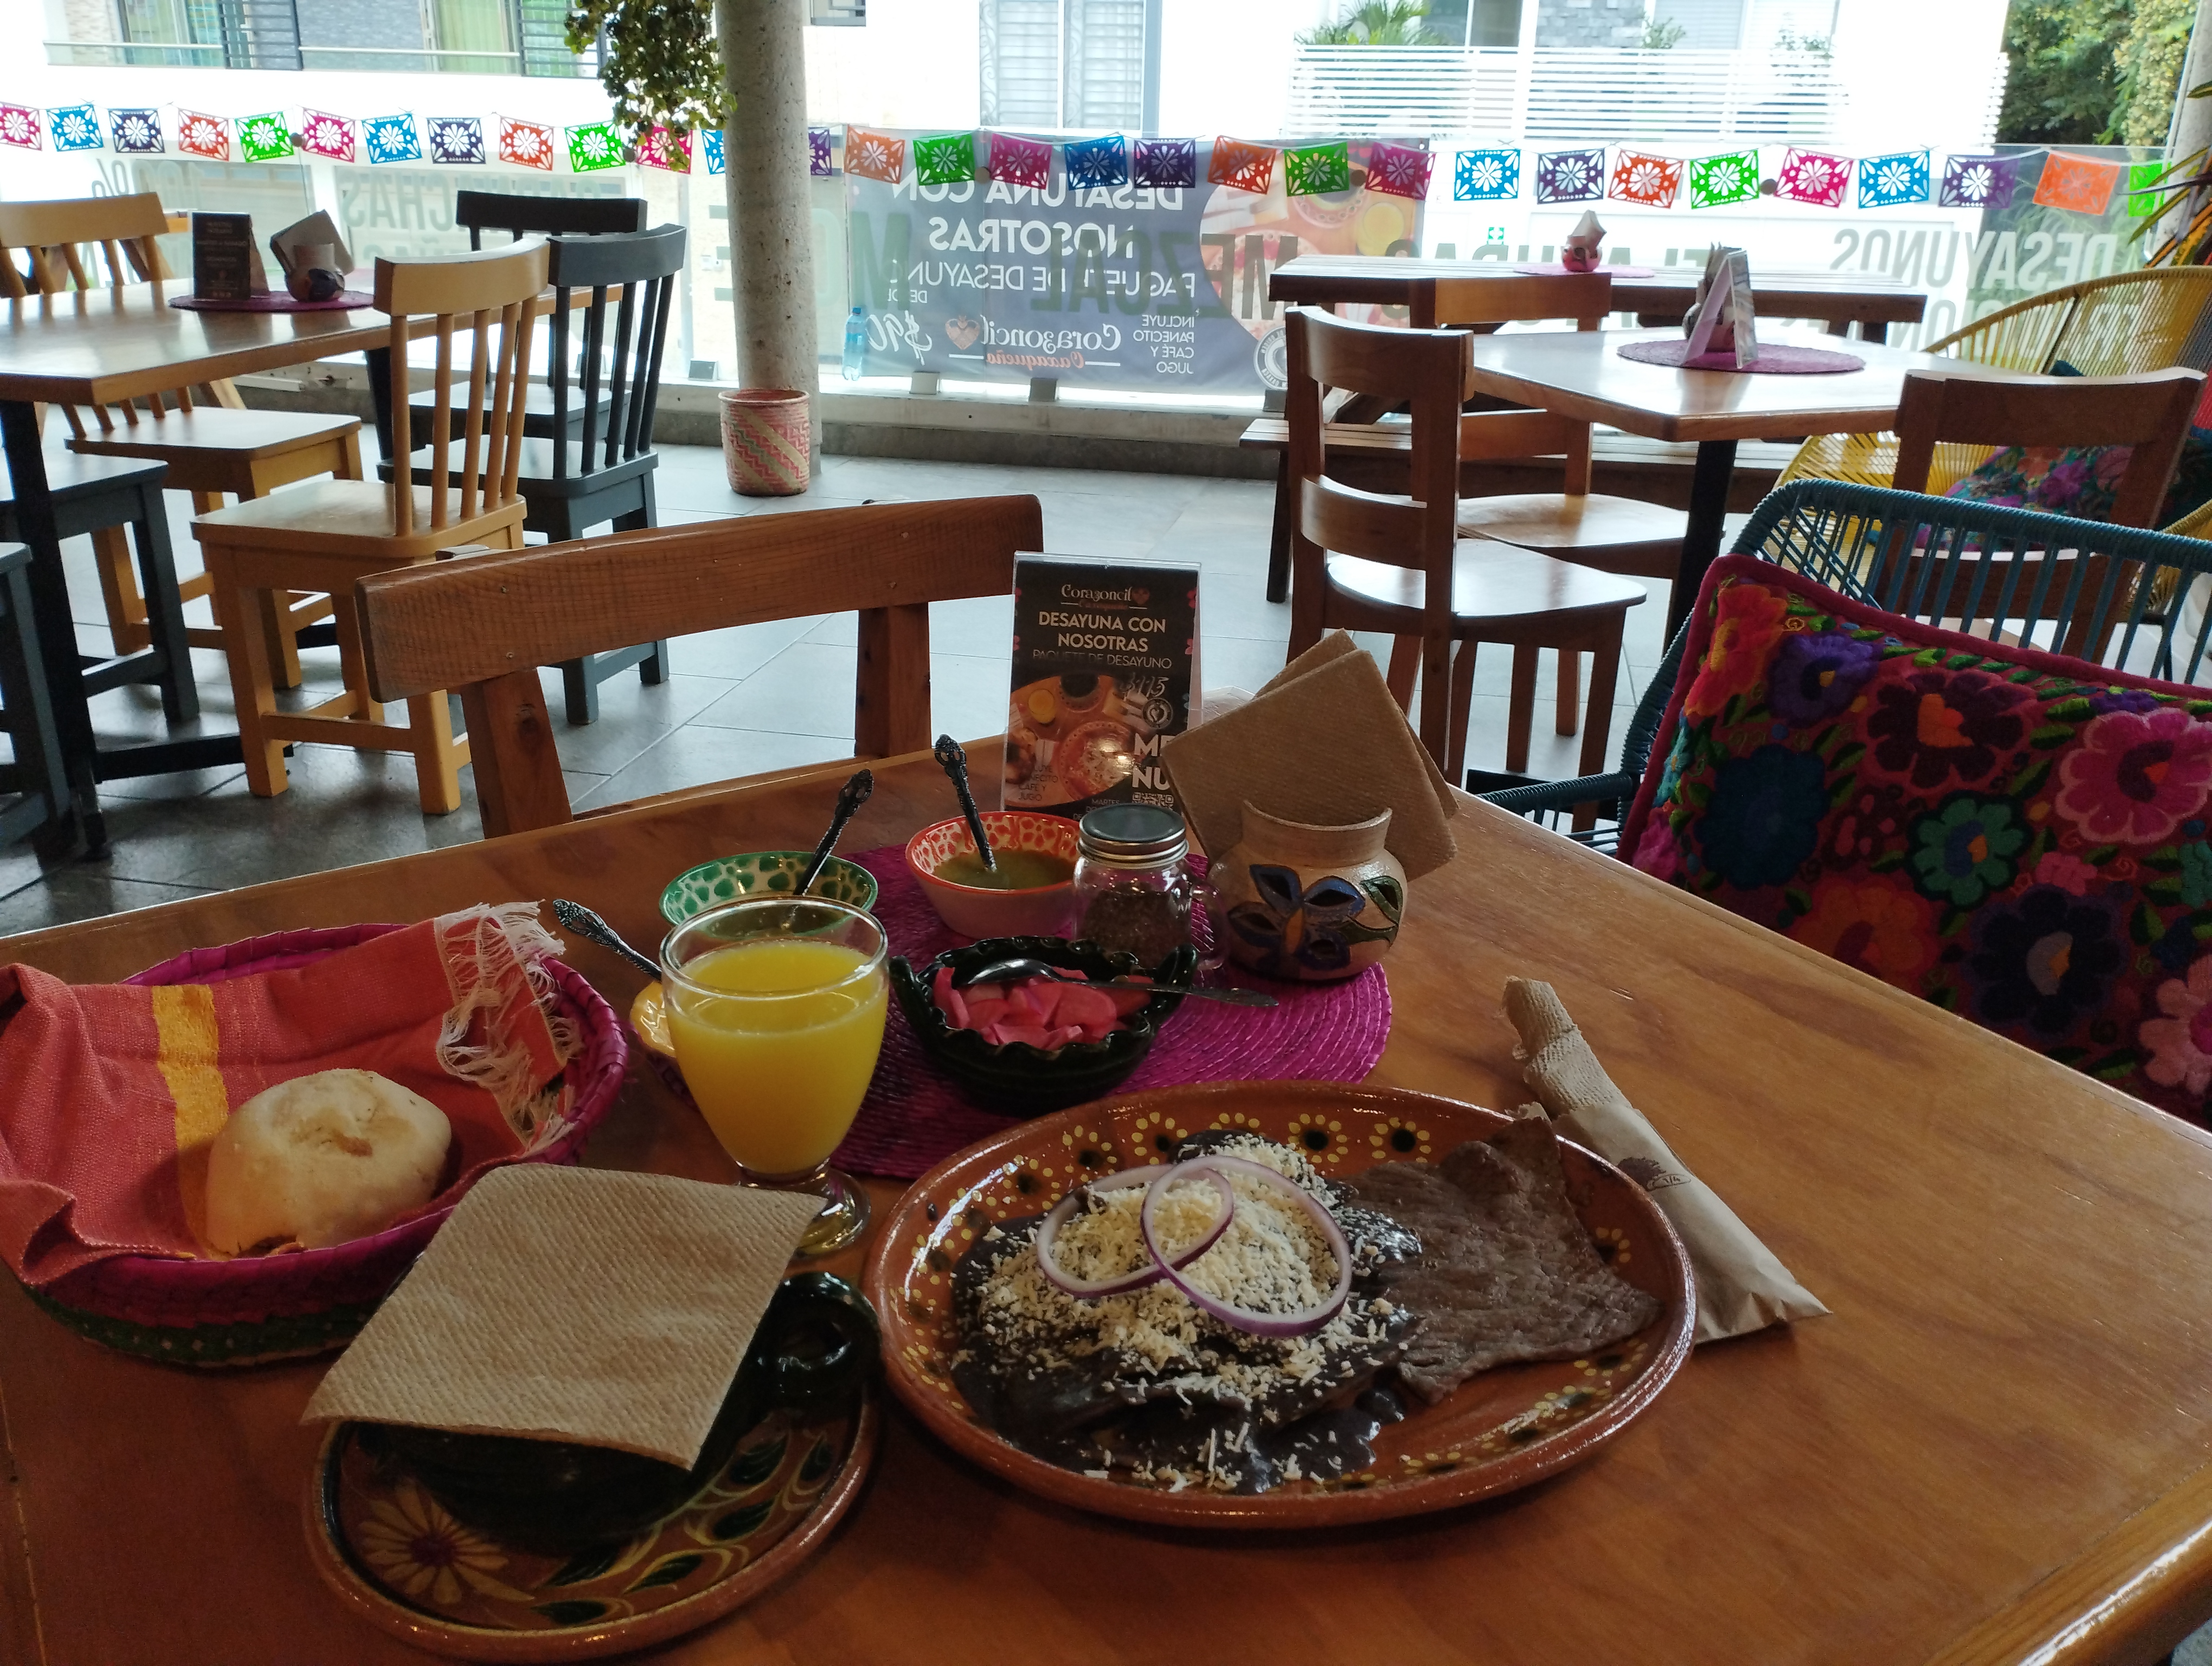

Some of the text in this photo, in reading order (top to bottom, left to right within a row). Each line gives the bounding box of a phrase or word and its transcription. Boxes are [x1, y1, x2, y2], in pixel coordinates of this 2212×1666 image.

[1061, 584, 1133, 603] Corazoncil
[1039, 611, 1166, 633] DESAYUNA CON
[1058, 633, 1149, 652] NOSOTRAS
[1033, 649, 1172, 670] PAQUETE DE DESAYUNO
